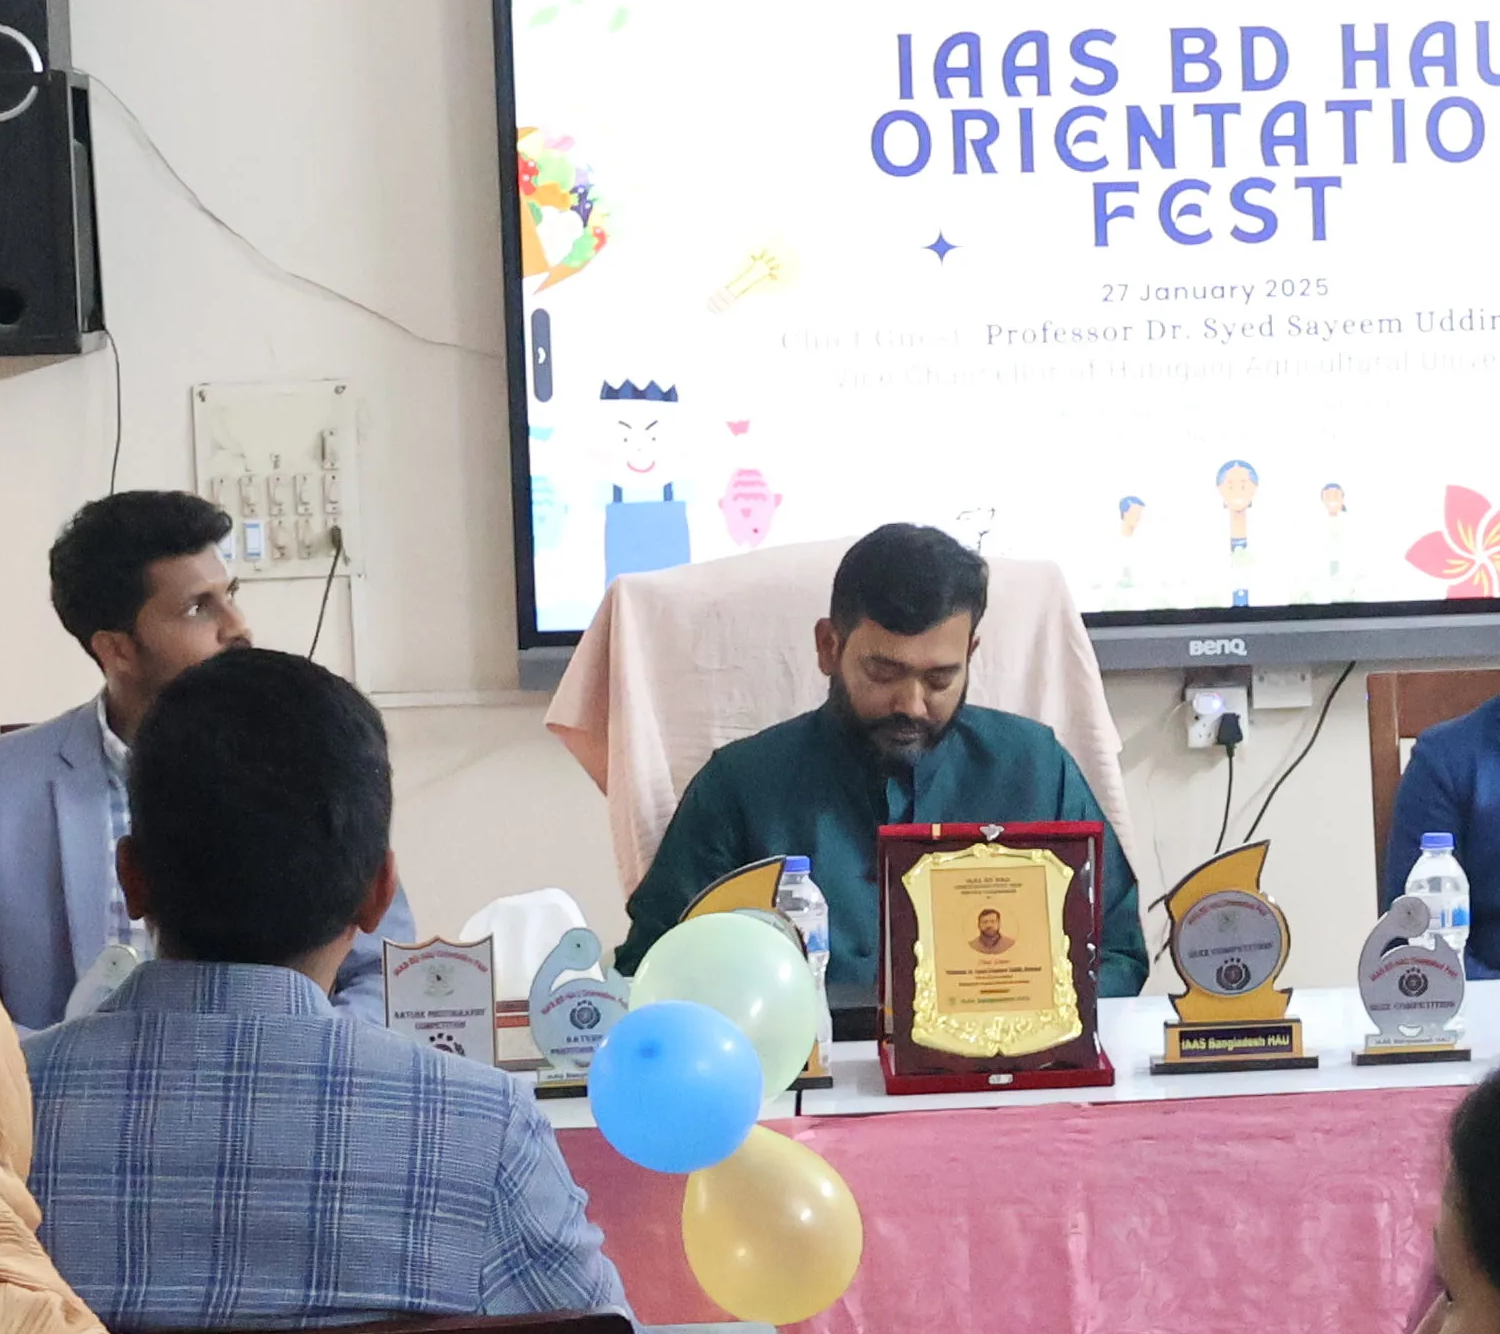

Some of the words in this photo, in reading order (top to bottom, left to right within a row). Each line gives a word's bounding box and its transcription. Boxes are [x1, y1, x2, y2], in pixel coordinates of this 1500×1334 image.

[897, 28, 1119, 100] IAAS
[1169, 26, 1290, 94] BD
[1092, 175, 1342, 247] FEST
[1102, 284, 1130, 303] 27
[1141, 281, 1255, 305] January
[1266, 278, 1330, 299] 2025
[986, 320, 1134, 345] Professor
[1146, 319, 1191, 342] Dr.
[1203, 314, 1274, 344] Syed
[1288, 314, 1404, 343] Sayeem
[1189, 638, 1248, 656] BenQ
[1182, 1037, 1206, 1050] IAAS
[1208, 1035, 1266, 1051] Bangladesh
[1268, 1033, 1290, 1047] HAU
